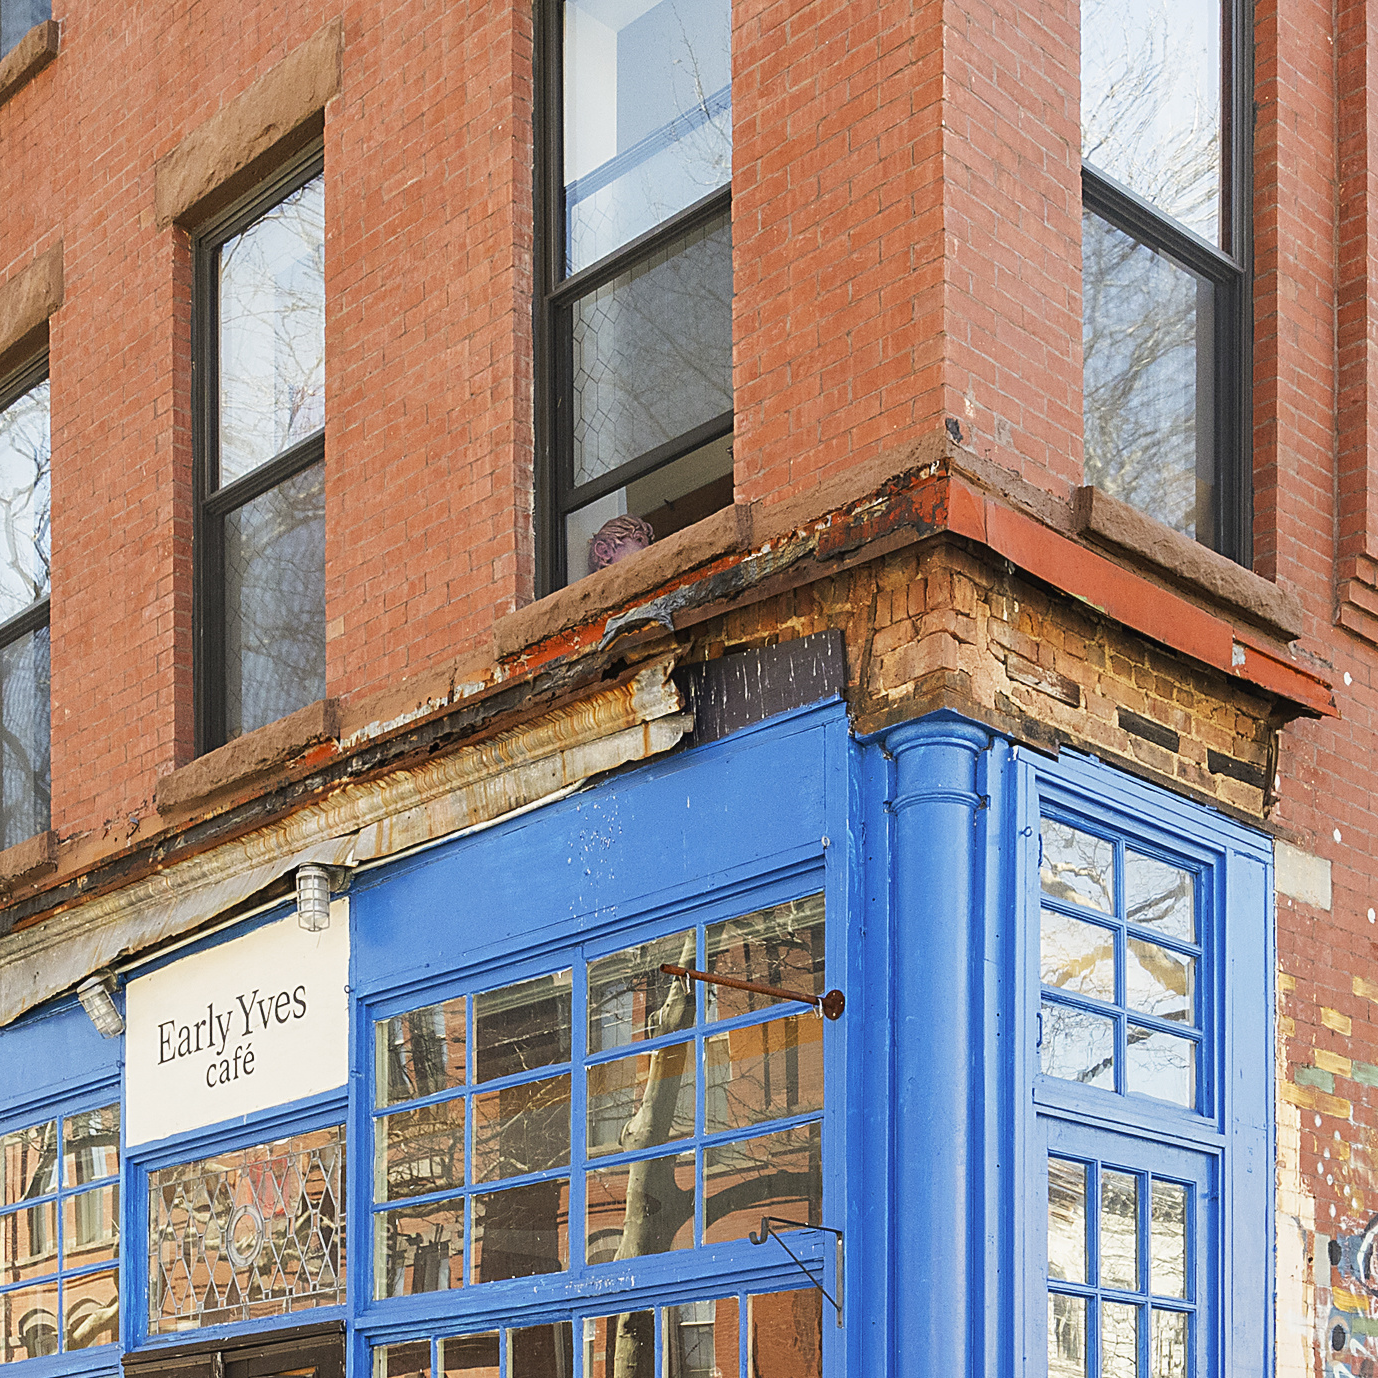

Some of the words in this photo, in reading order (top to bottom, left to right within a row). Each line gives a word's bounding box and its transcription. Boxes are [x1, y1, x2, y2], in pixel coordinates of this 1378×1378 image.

[157, 1002, 233, 1066] Early
[235, 984, 308, 1037] Yves
[205, 1043, 256, 1088] café
